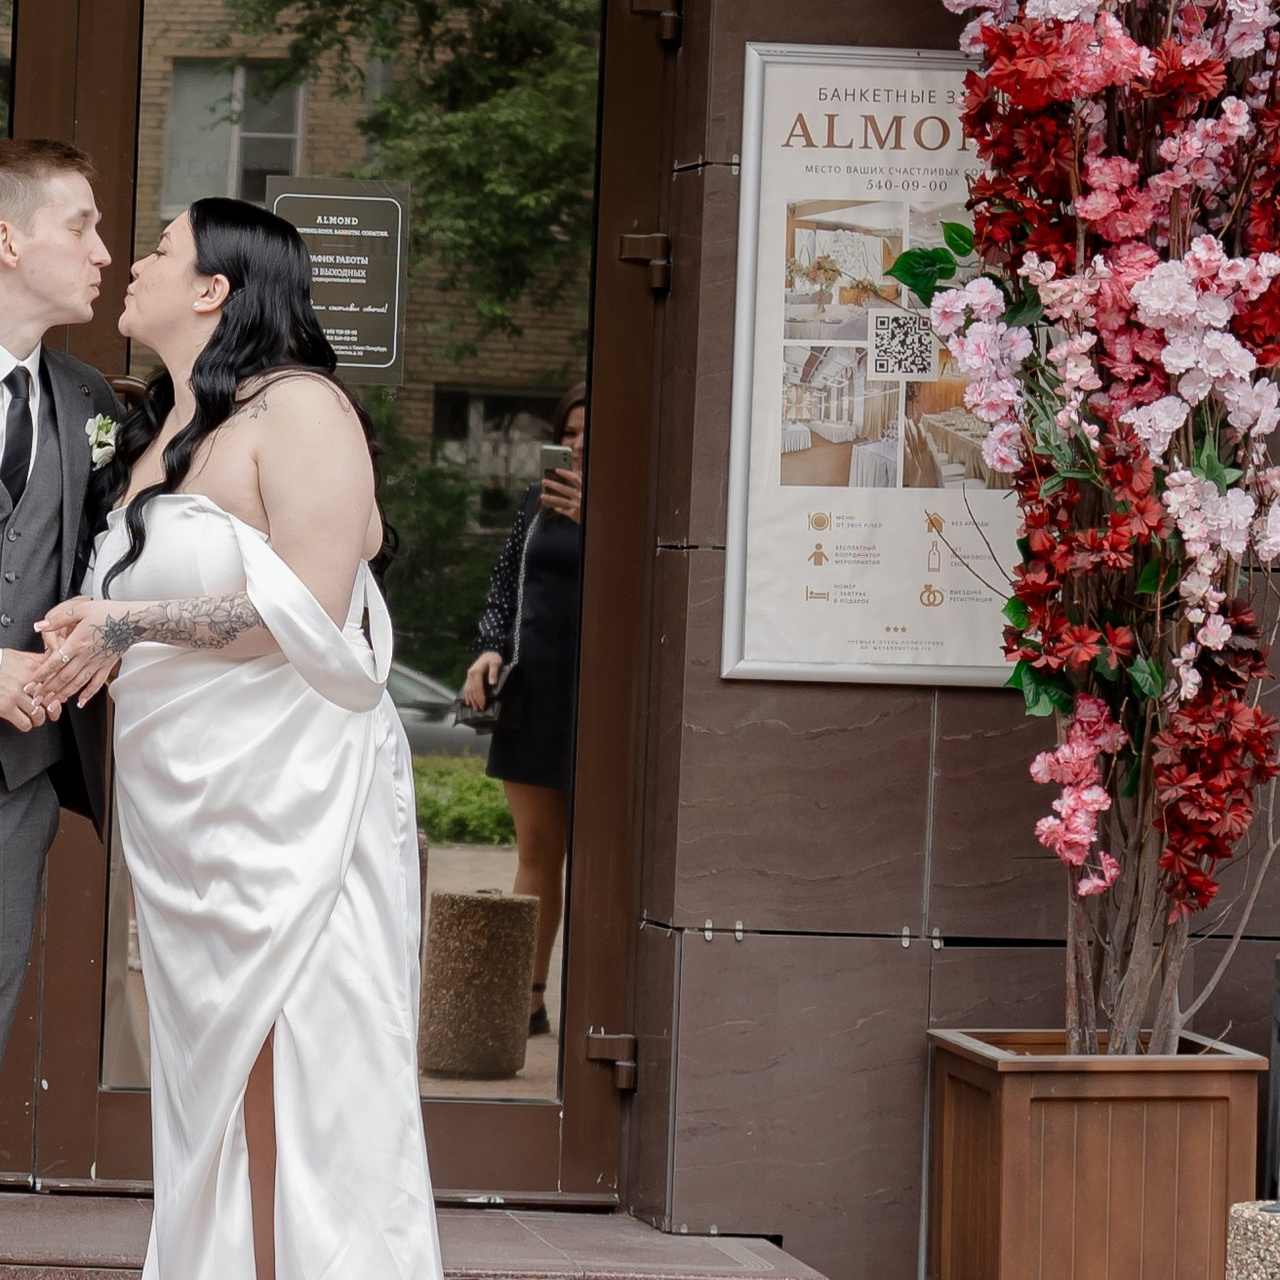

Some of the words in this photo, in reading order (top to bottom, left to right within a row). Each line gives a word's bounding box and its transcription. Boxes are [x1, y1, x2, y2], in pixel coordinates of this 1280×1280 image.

[818, 87, 937, 104] БАНКЕТНЫЕ
[805, 165, 842, 174] МЕСТО
[846, 166, 884, 175] ВАШИХ
[888, 167, 960, 177] СЧАСТЛИВЫХ
[866, 179, 948, 192] 540-09-00
[316, 215, 359, 225] ALMOND
[335, 255, 369, 265] РАБОТЫ
[320, 267, 367, 277] ВЫХОДНЫХ
